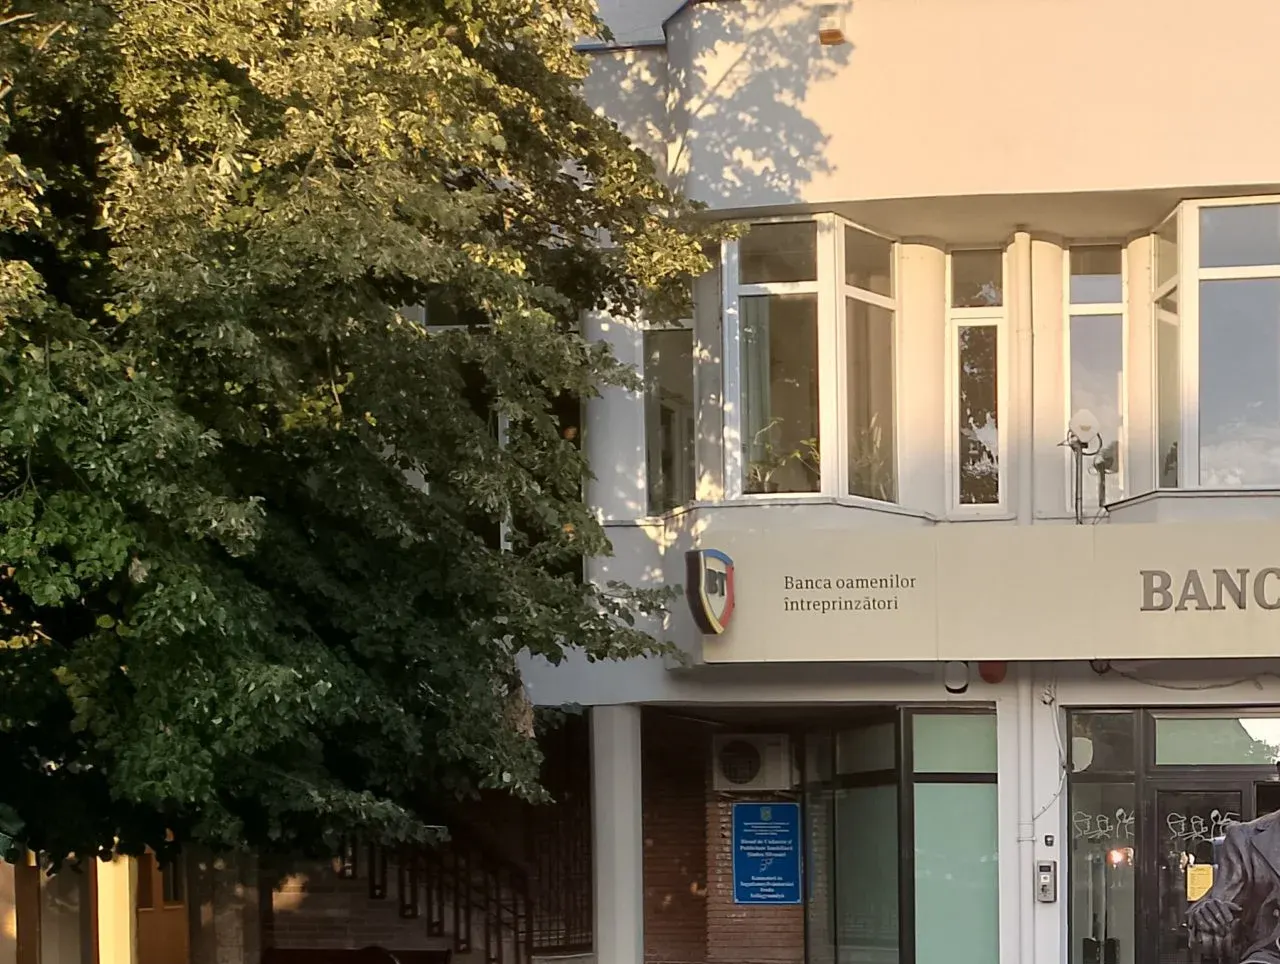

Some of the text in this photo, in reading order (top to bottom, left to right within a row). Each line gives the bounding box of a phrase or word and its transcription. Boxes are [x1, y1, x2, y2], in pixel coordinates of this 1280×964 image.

[706, 568, 727, 596] BT
[784, 574, 917, 590] Banca oamenilor
[784, 596, 899, 613] întreprinzători
